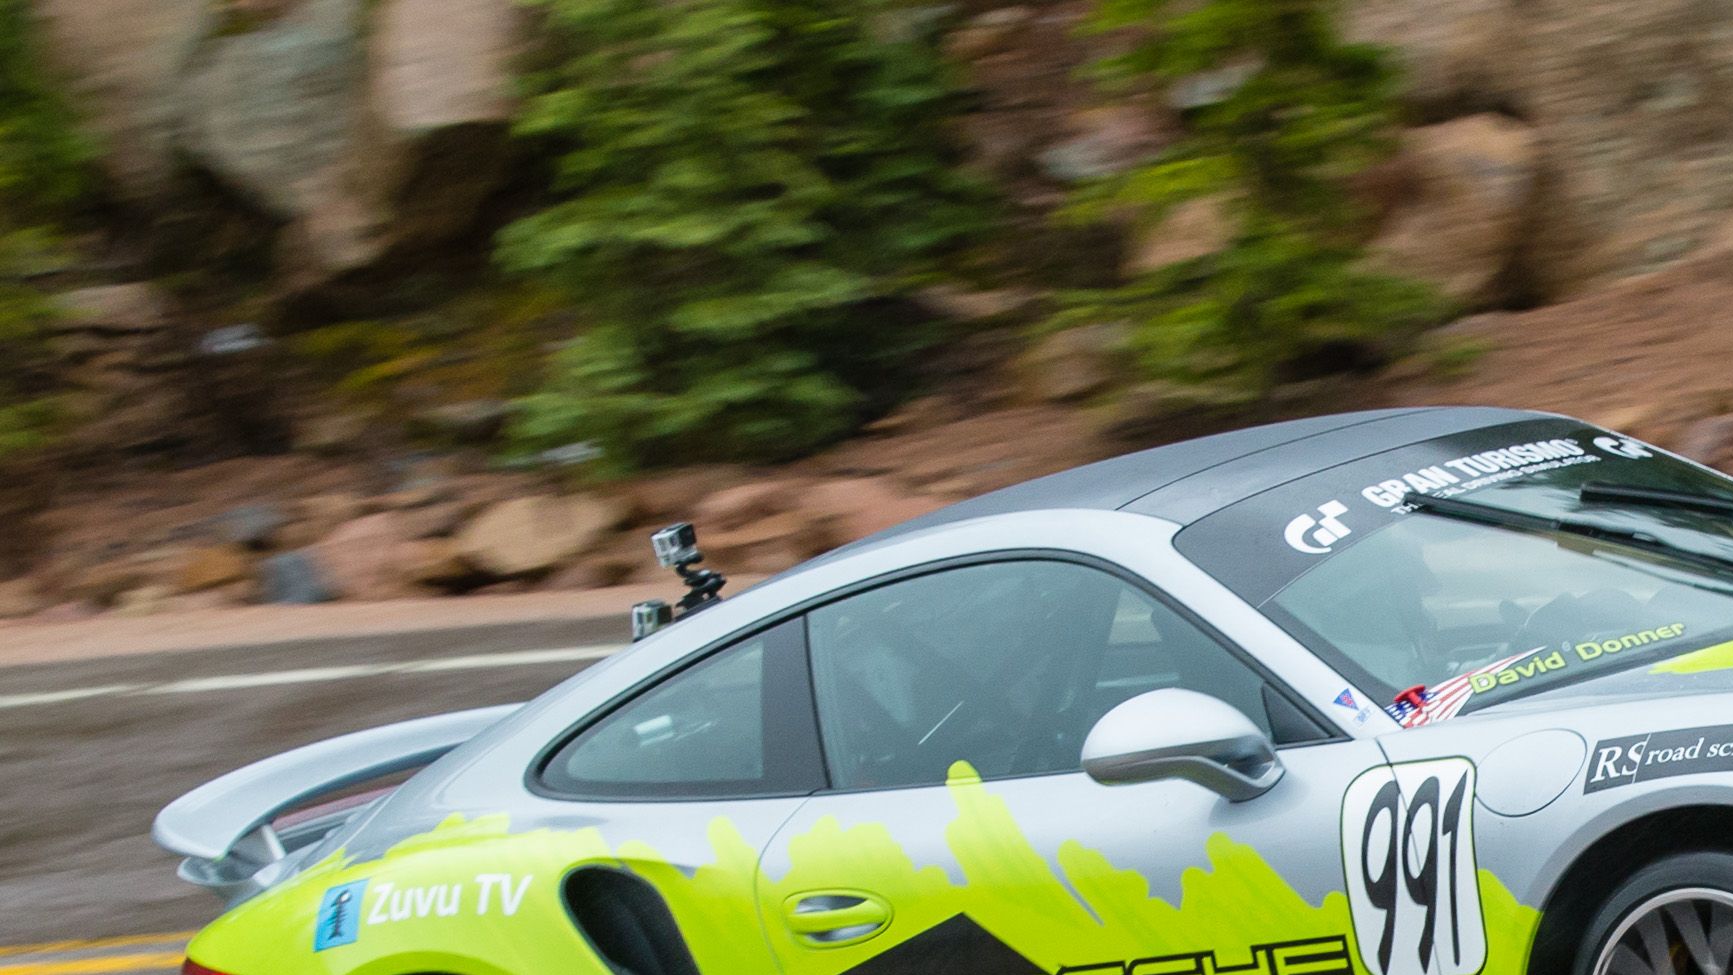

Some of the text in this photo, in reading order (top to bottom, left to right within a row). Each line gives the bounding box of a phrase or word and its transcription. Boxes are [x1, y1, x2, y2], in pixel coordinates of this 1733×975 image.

[1361, 466, 1460, 508] GRAN
[1468, 622, 1687, 695] David Donner
[1645, 737, 1705, 766] road
[366, 872, 535, 926] Zuvu TV
